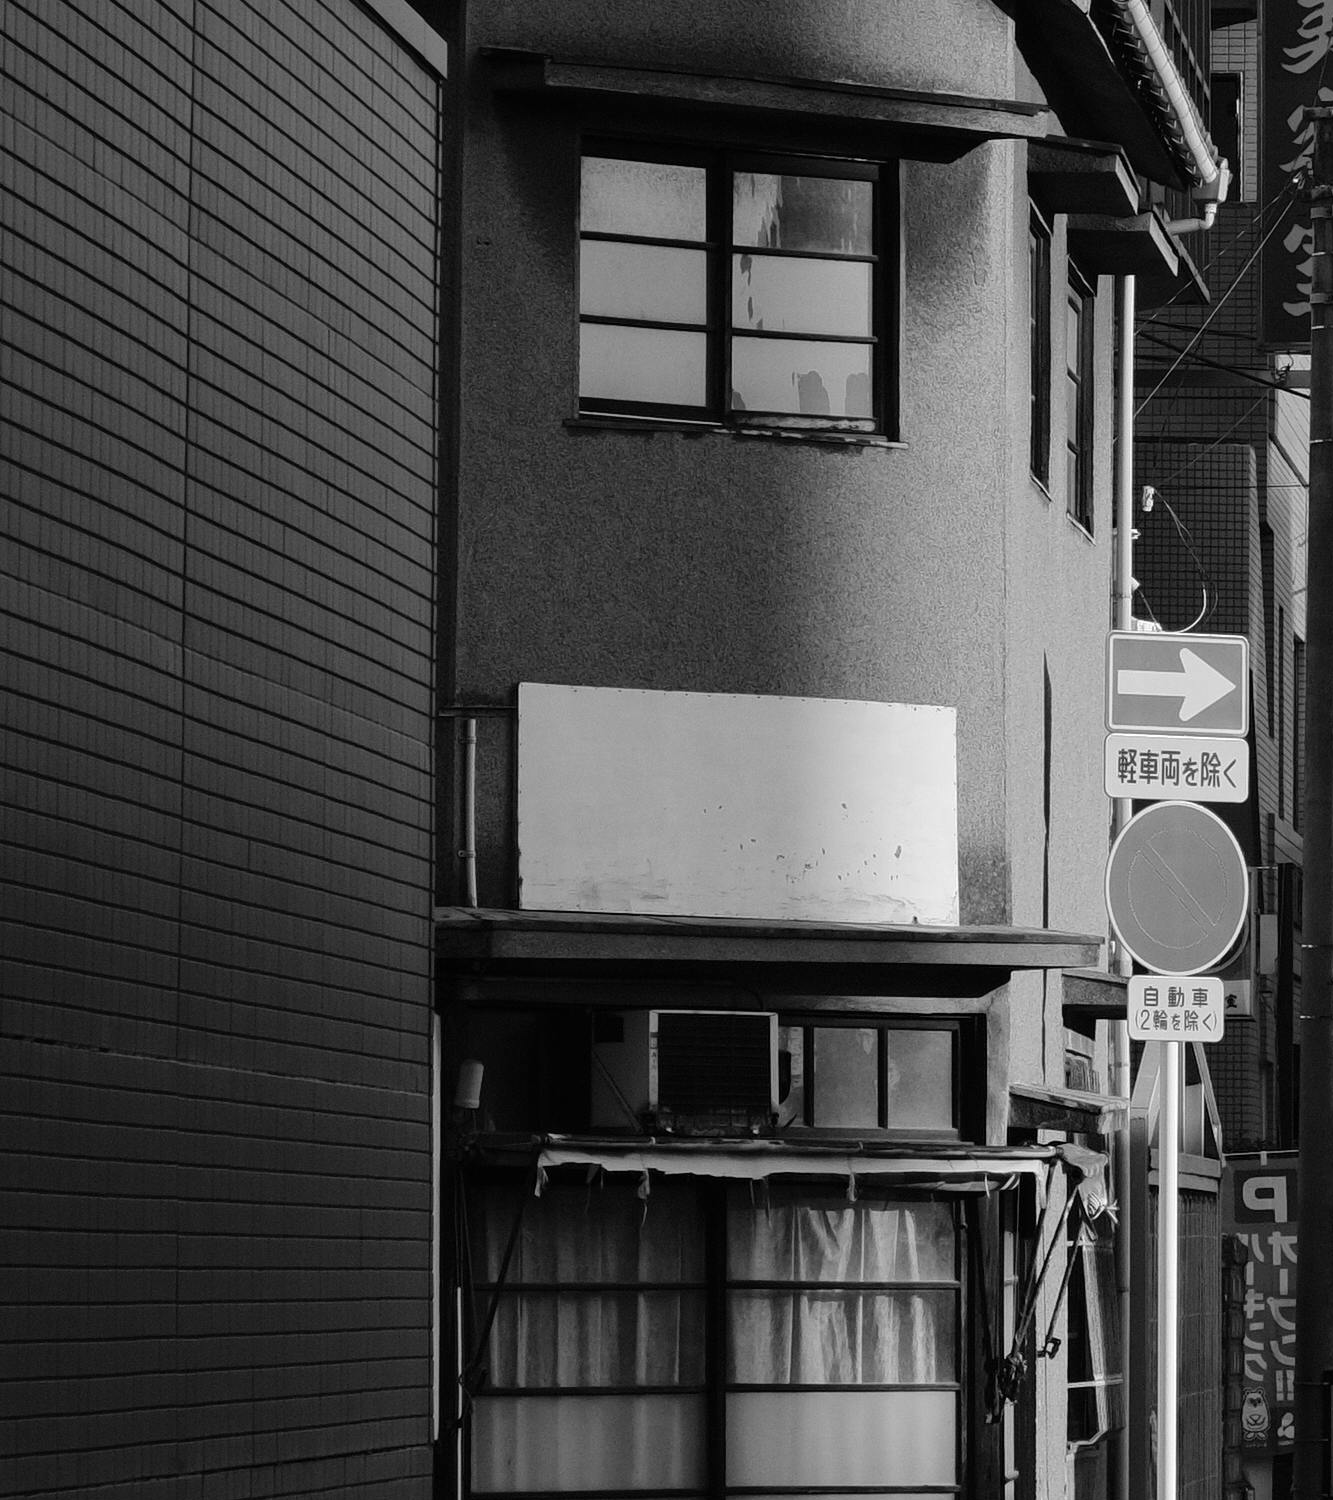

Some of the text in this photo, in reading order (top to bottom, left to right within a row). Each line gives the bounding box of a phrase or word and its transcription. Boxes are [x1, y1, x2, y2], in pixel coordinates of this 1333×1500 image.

[1117, 748, 1237, 789] 軽車両を除く
[1142, 985, 1208, 1009] 自動車
[1135, 1008, 1217, 1034] (2輪を除く)
